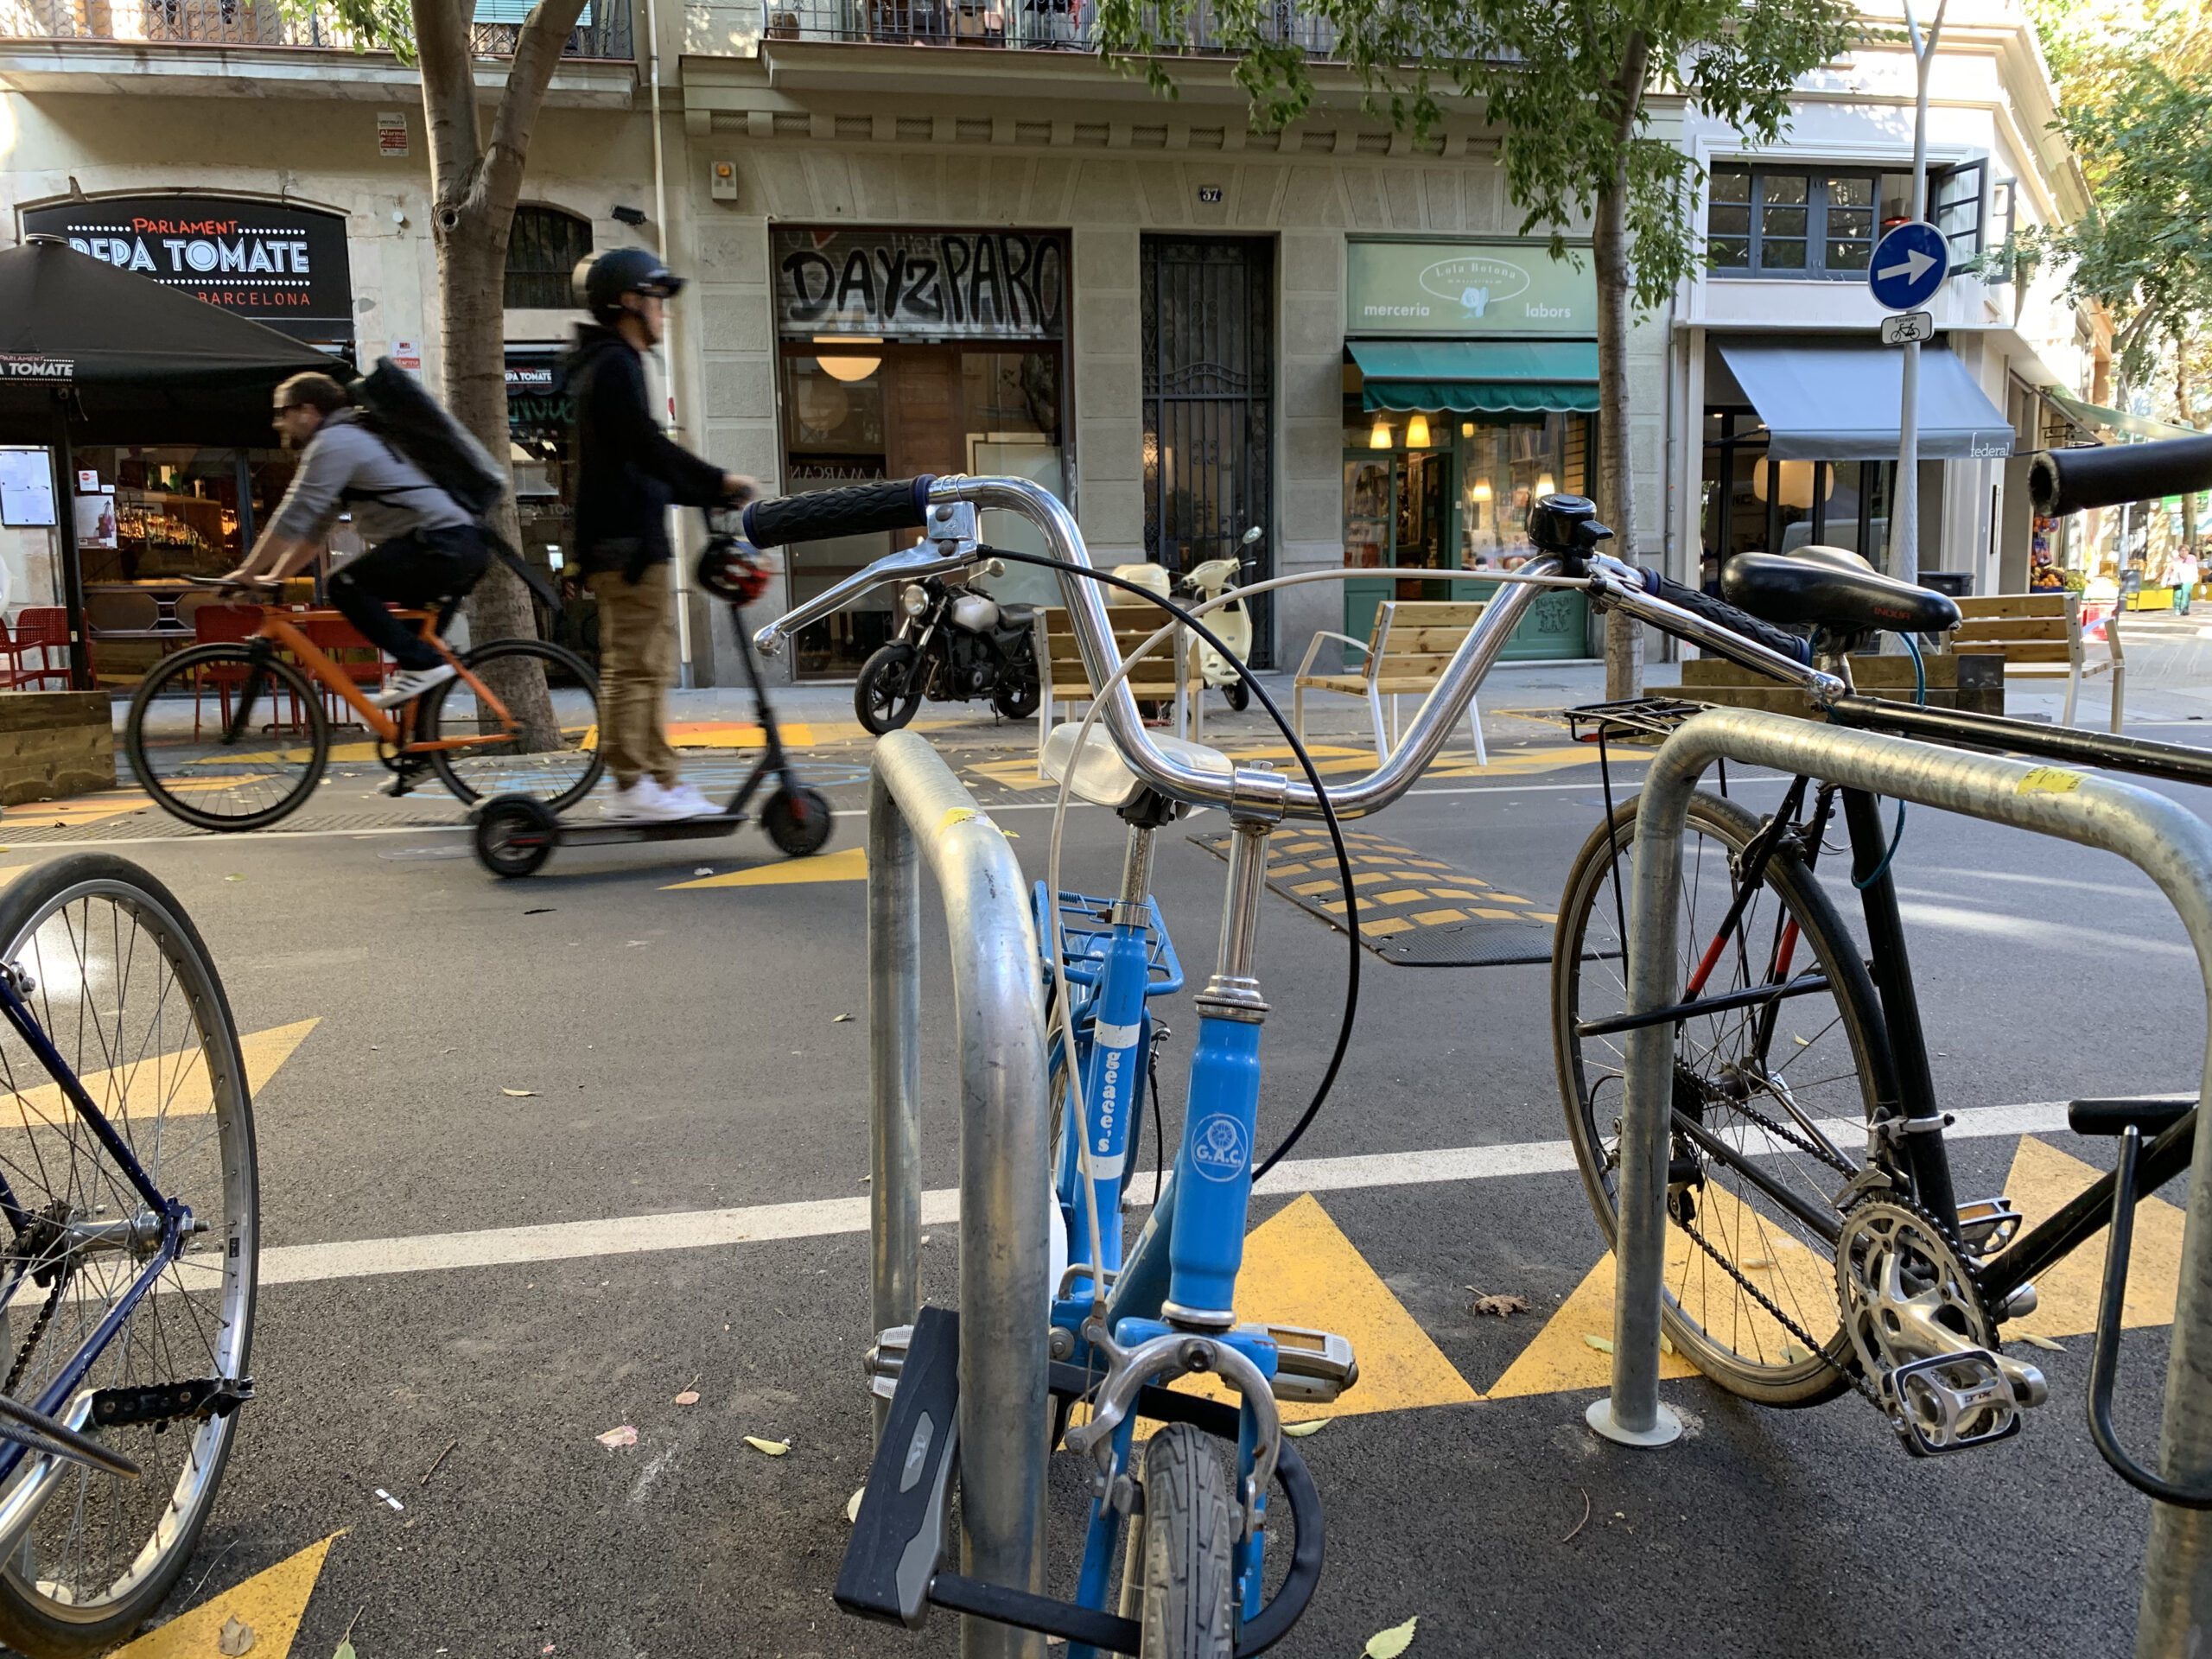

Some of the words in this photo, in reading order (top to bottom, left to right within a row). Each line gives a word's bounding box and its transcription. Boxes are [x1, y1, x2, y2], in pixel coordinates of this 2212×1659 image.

[1202, 188, 1218, 200] 37
[132, 218, 238, 235] PARLAMENT
[163, 237, 309, 273] TOMATE
[1436, 263, 1465, 276] Lola
[1471, 263, 1516, 279] Botona
[198, 292, 310, 306] BARCELONA
[1364, 303, 1430, 316] merceria
[1526, 303, 1571, 318] labors
[9, 361, 74, 377] TOMATE
[519, 372, 552, 381] TOMATE
[1970, 431, 2010, 457] federal
